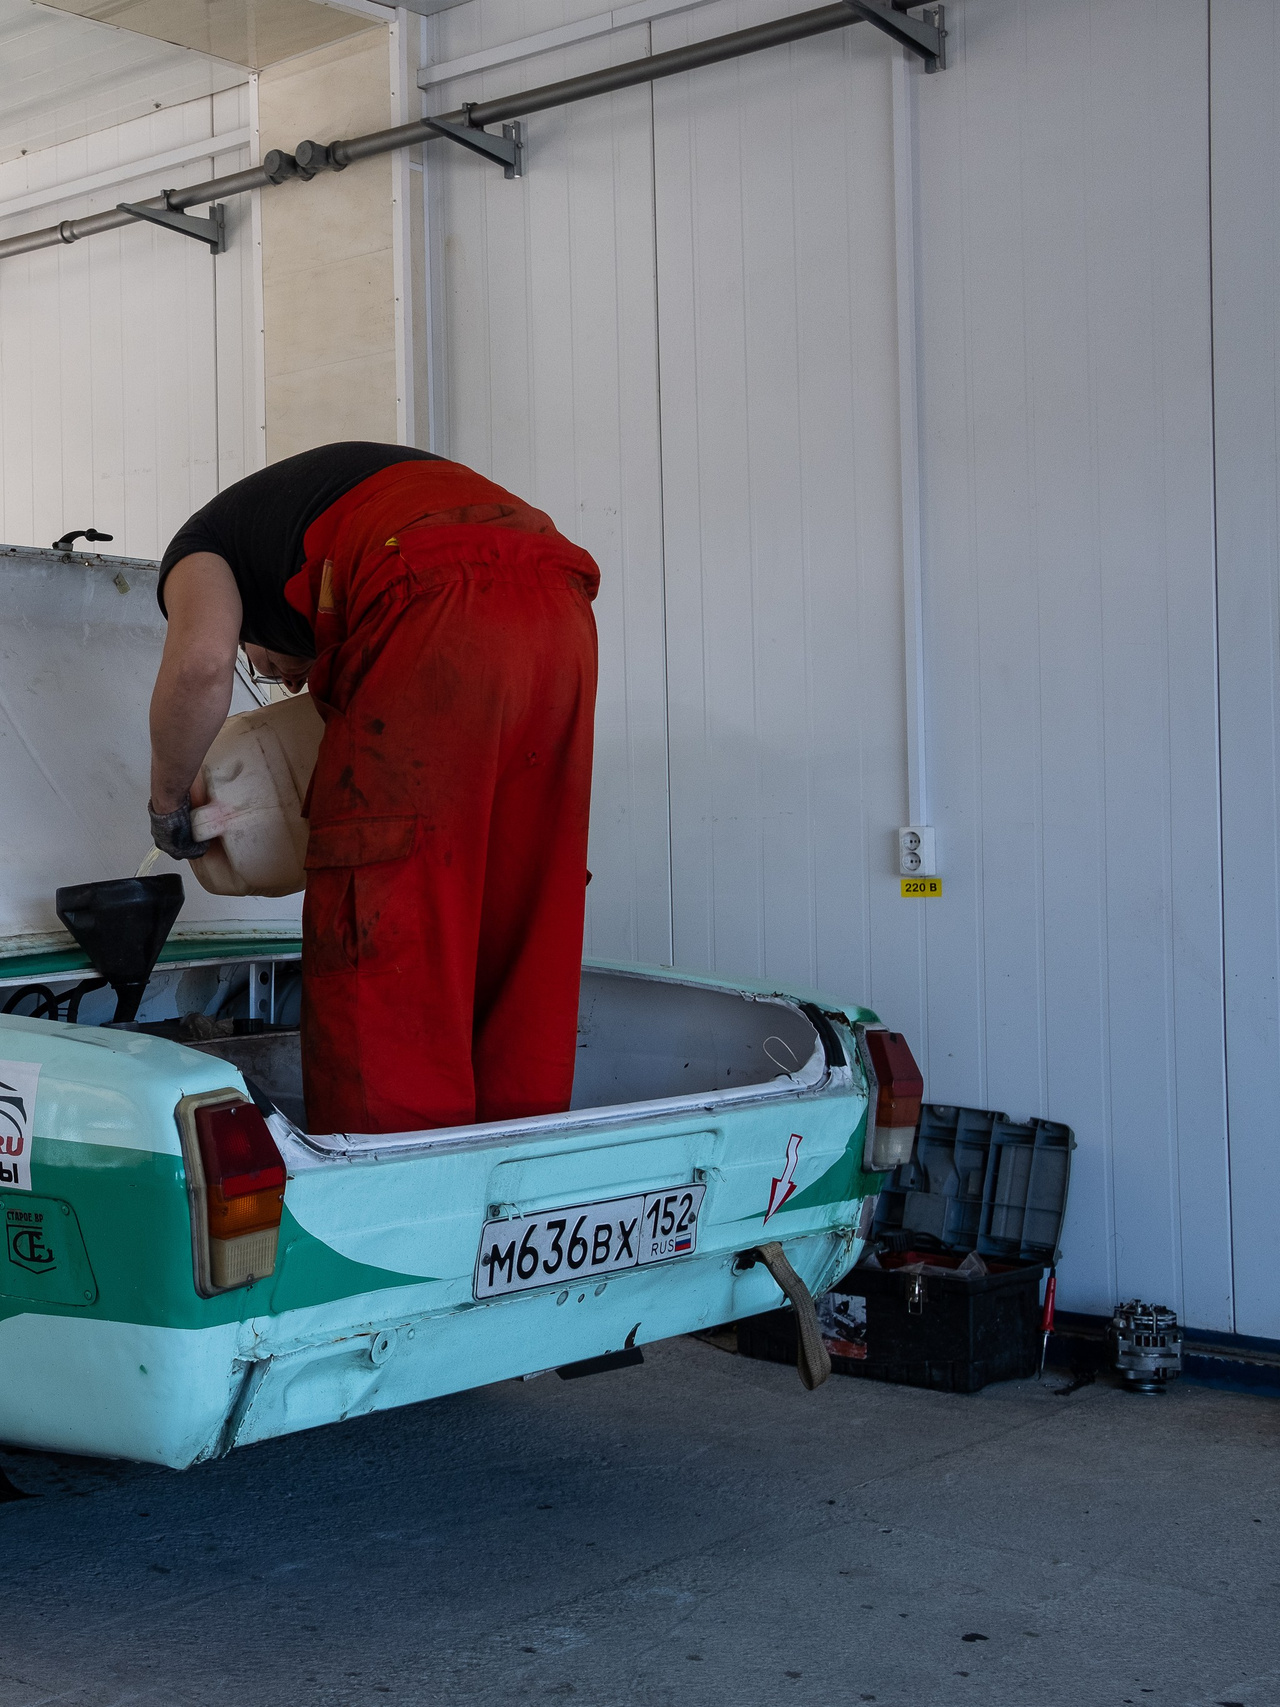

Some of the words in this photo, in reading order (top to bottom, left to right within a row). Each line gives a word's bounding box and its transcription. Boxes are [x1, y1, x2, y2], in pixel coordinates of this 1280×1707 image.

[905, 883, 926, 892] 220
[6, 1210, 33, 1222] СТАРОЕ
[646, 1192, 694, 1239] 152
[650, 1238, 675, 1257] RUS
